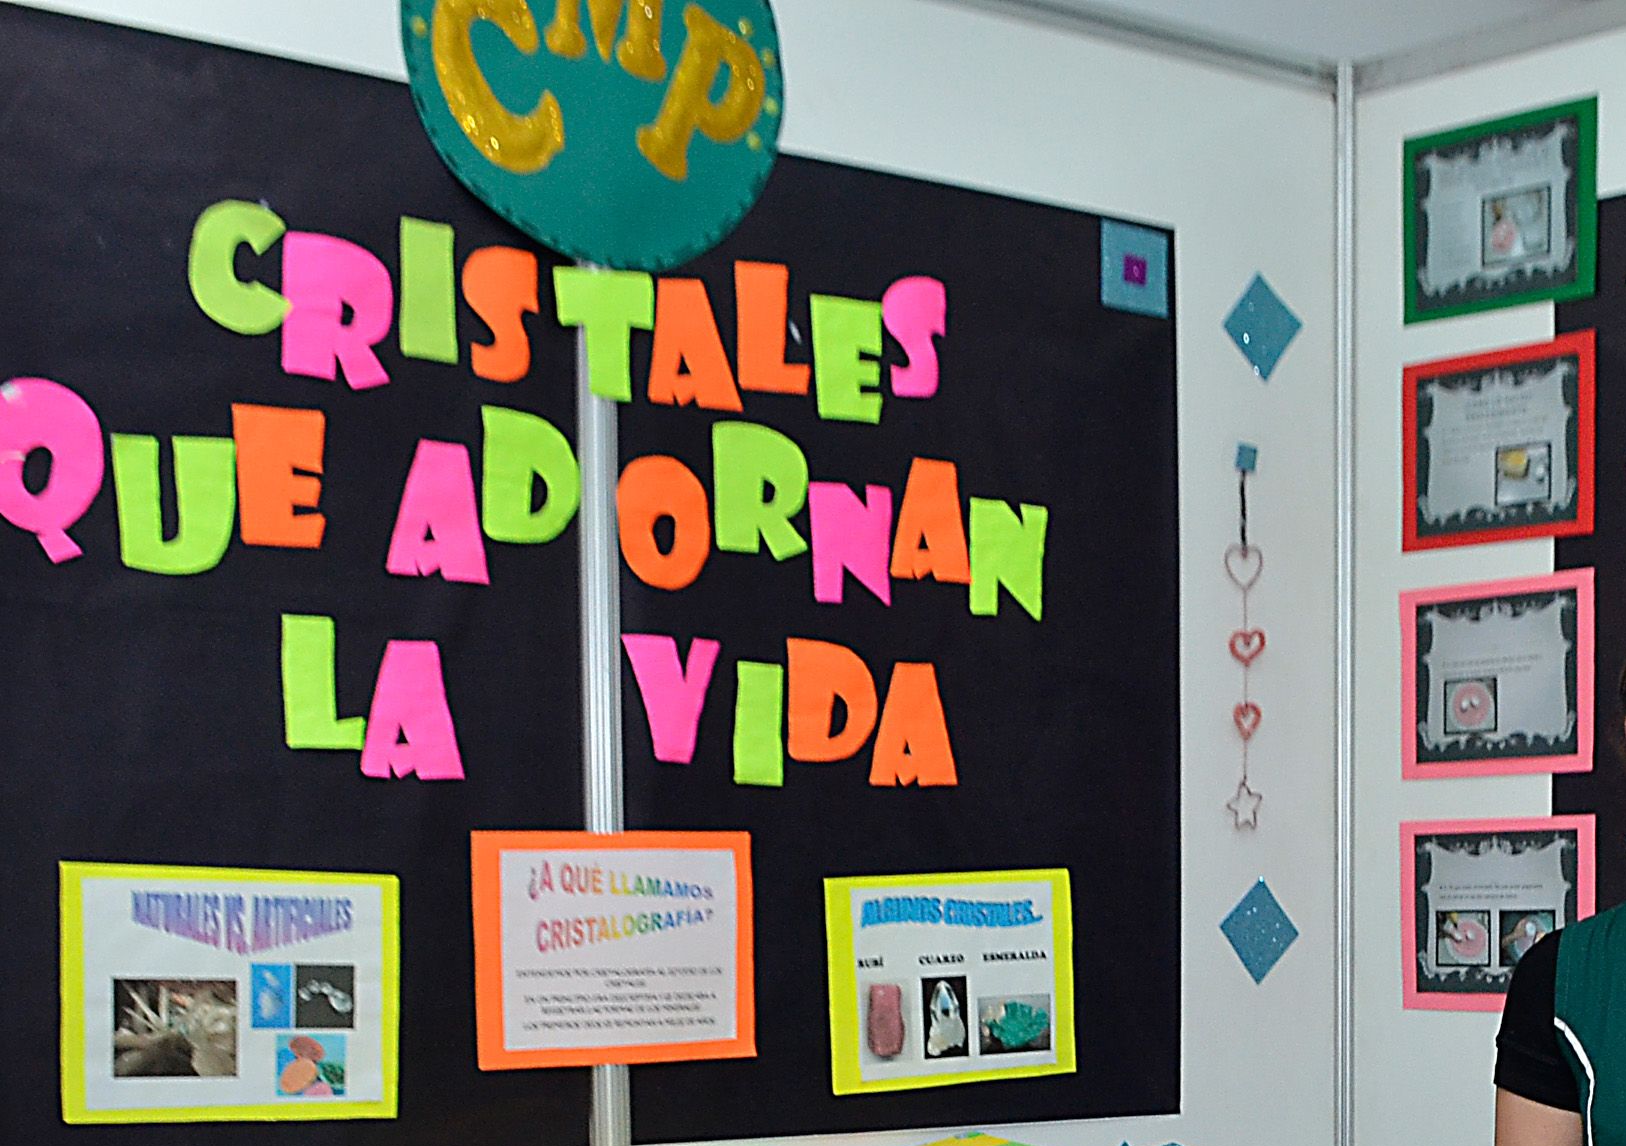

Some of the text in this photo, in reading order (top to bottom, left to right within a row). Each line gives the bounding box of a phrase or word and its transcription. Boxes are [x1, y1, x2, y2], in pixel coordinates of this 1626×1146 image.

[188, 199, 947, 424] CRISTALES
[0, 377, 1048, 621] QUE ADORNAN
[281, 614, 958, 786] LA VIDA
[528, 860, 554, 900] ¿A
[609, 871, 714, 899] LLAMAMOS
[535, 906, 714, 954] CRISTALOGRAFÍA?
[861, 896, 942, 928] ALGUNOS
[918, 953, 965, 967] CUARZO
[983, 950, 1047, 963] ESMERALDA
